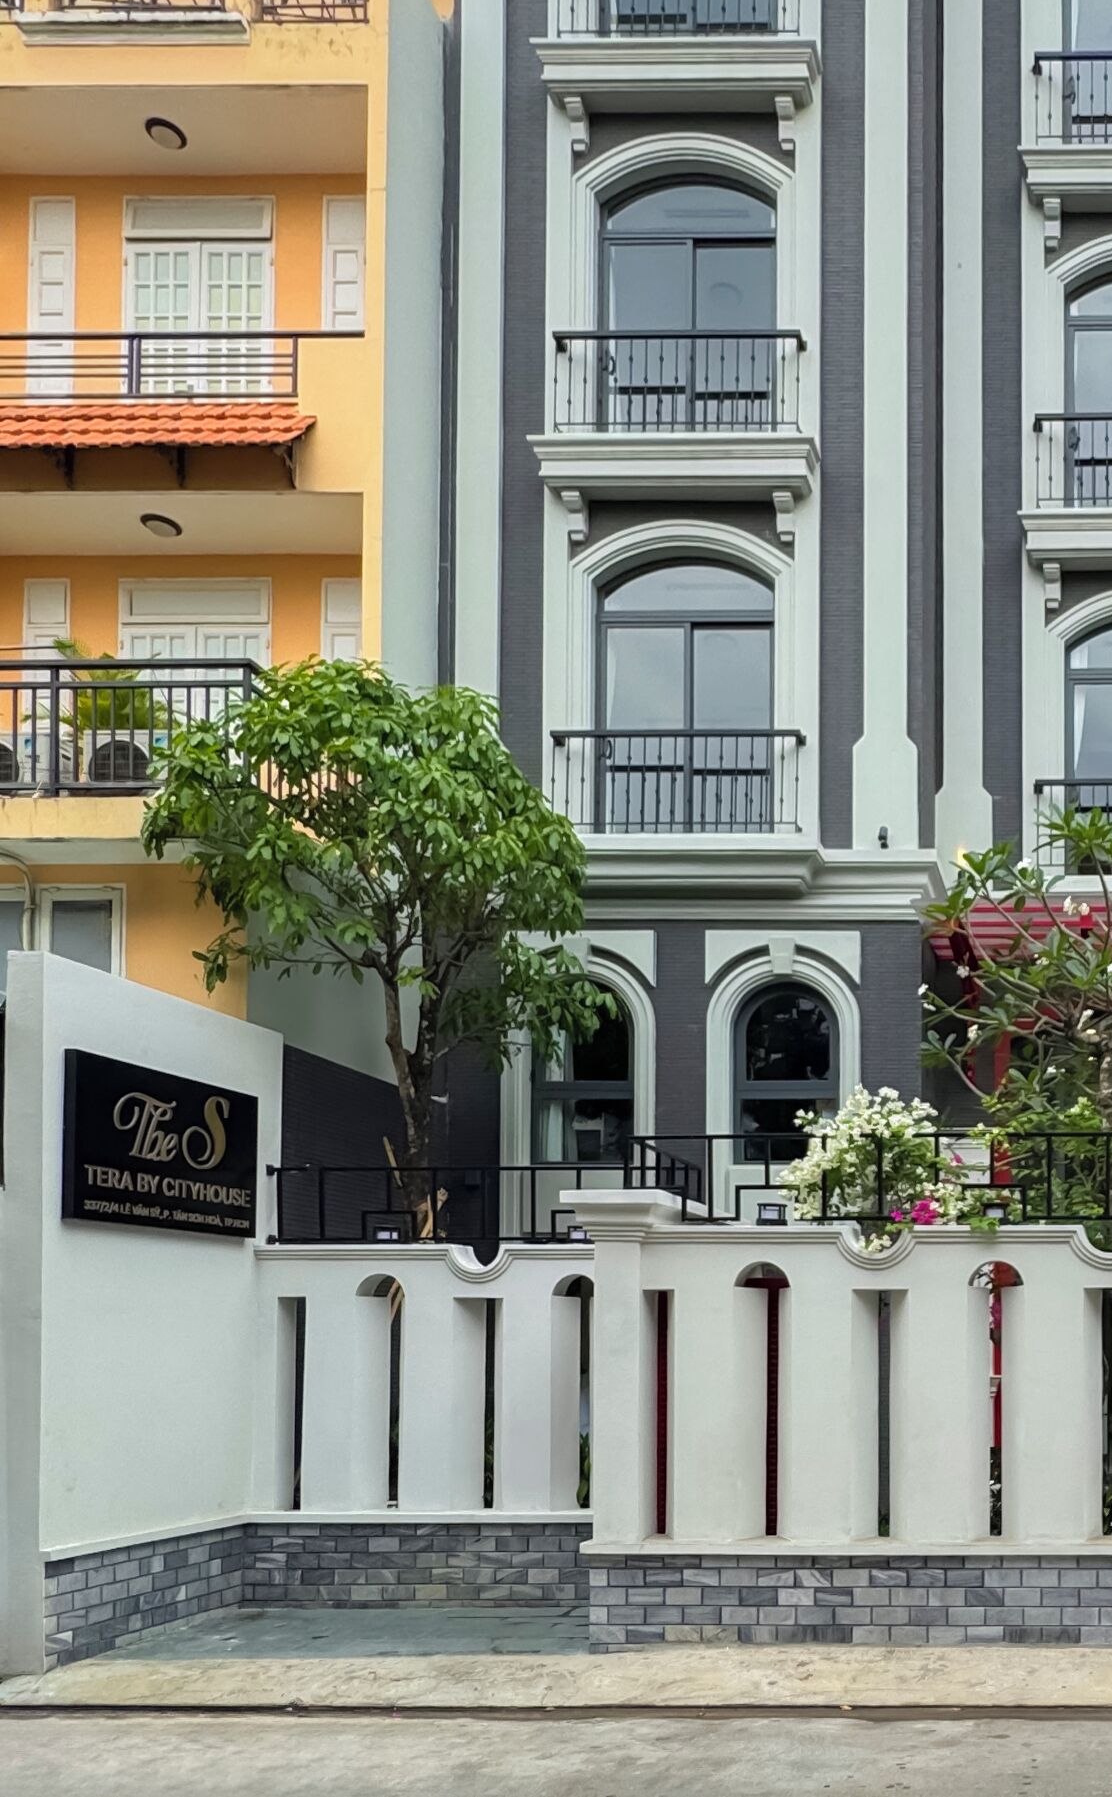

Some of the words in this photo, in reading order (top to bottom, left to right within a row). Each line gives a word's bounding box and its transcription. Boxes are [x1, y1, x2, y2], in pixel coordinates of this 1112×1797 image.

[113, 1092, 179, 1162] The
[182, 1096, 231, 1170] S
[84, 1164, 134, 1191] TERA
[137, 1172, 160, 1194] BY
[162, 1177, 252, 1208] CITYHOUSE
